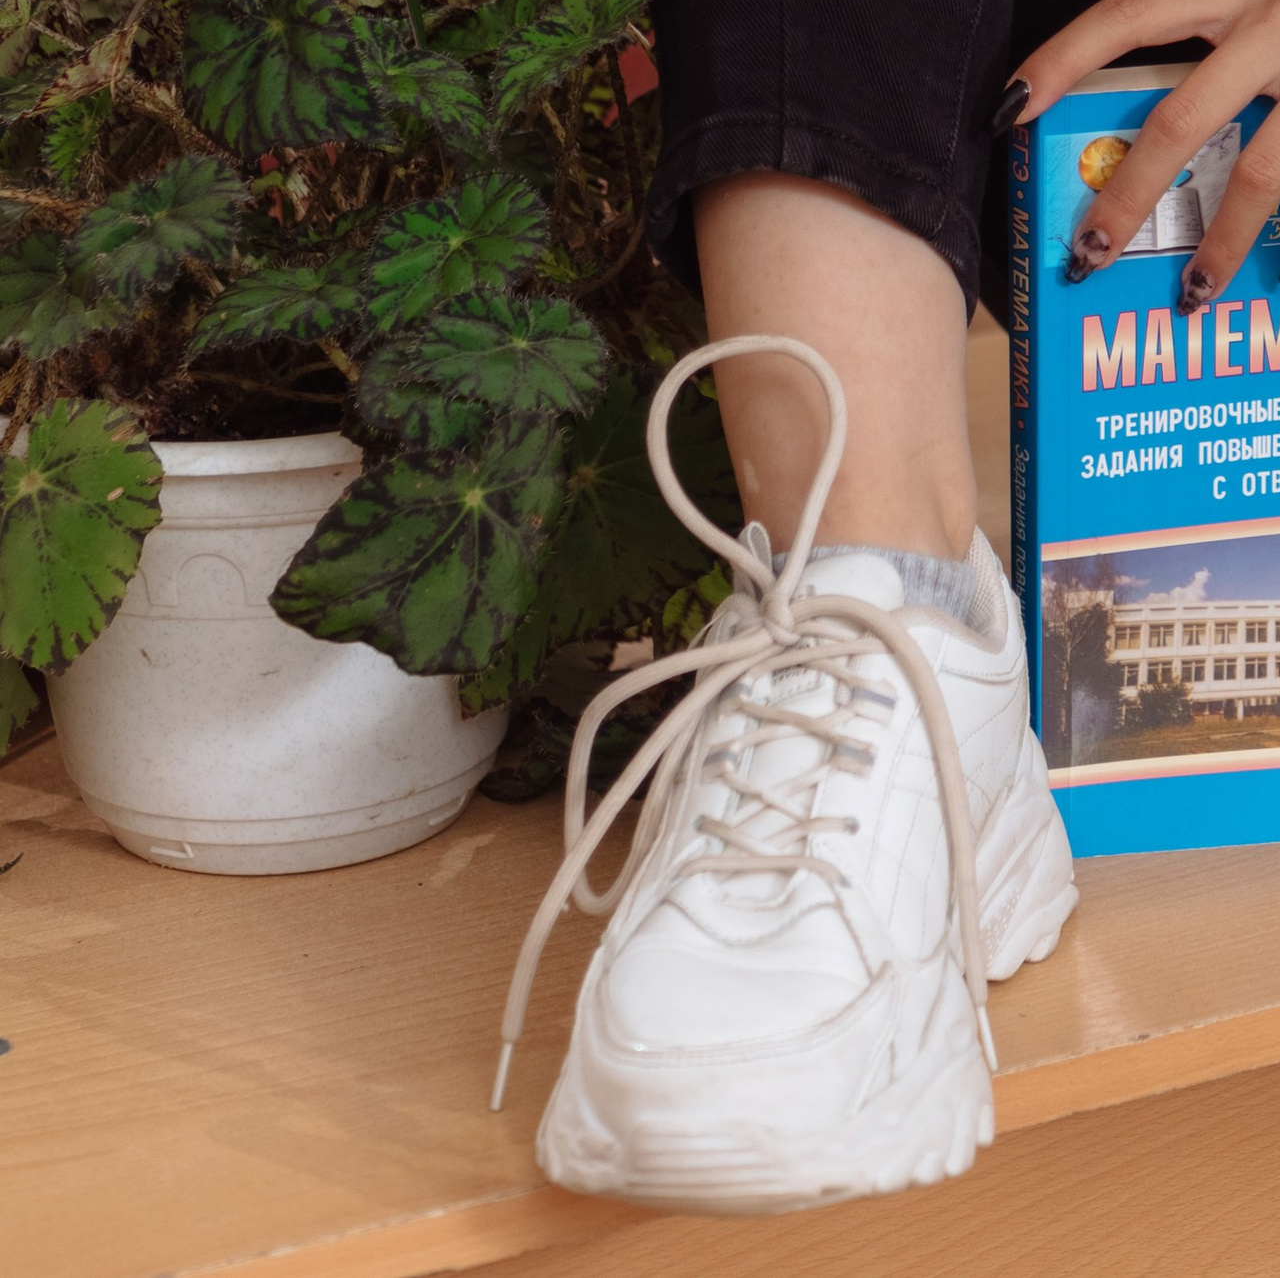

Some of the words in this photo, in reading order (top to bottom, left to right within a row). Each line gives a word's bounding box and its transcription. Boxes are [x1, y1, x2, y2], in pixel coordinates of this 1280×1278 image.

[1012, 206, 1030, 410] МАТЕМАТИКА
[1014, 444, 1030, 542] Задания
[1081, 445, 1183, 479] ЗАДАНИЯ
[1213, 476, 1226, 499] С
